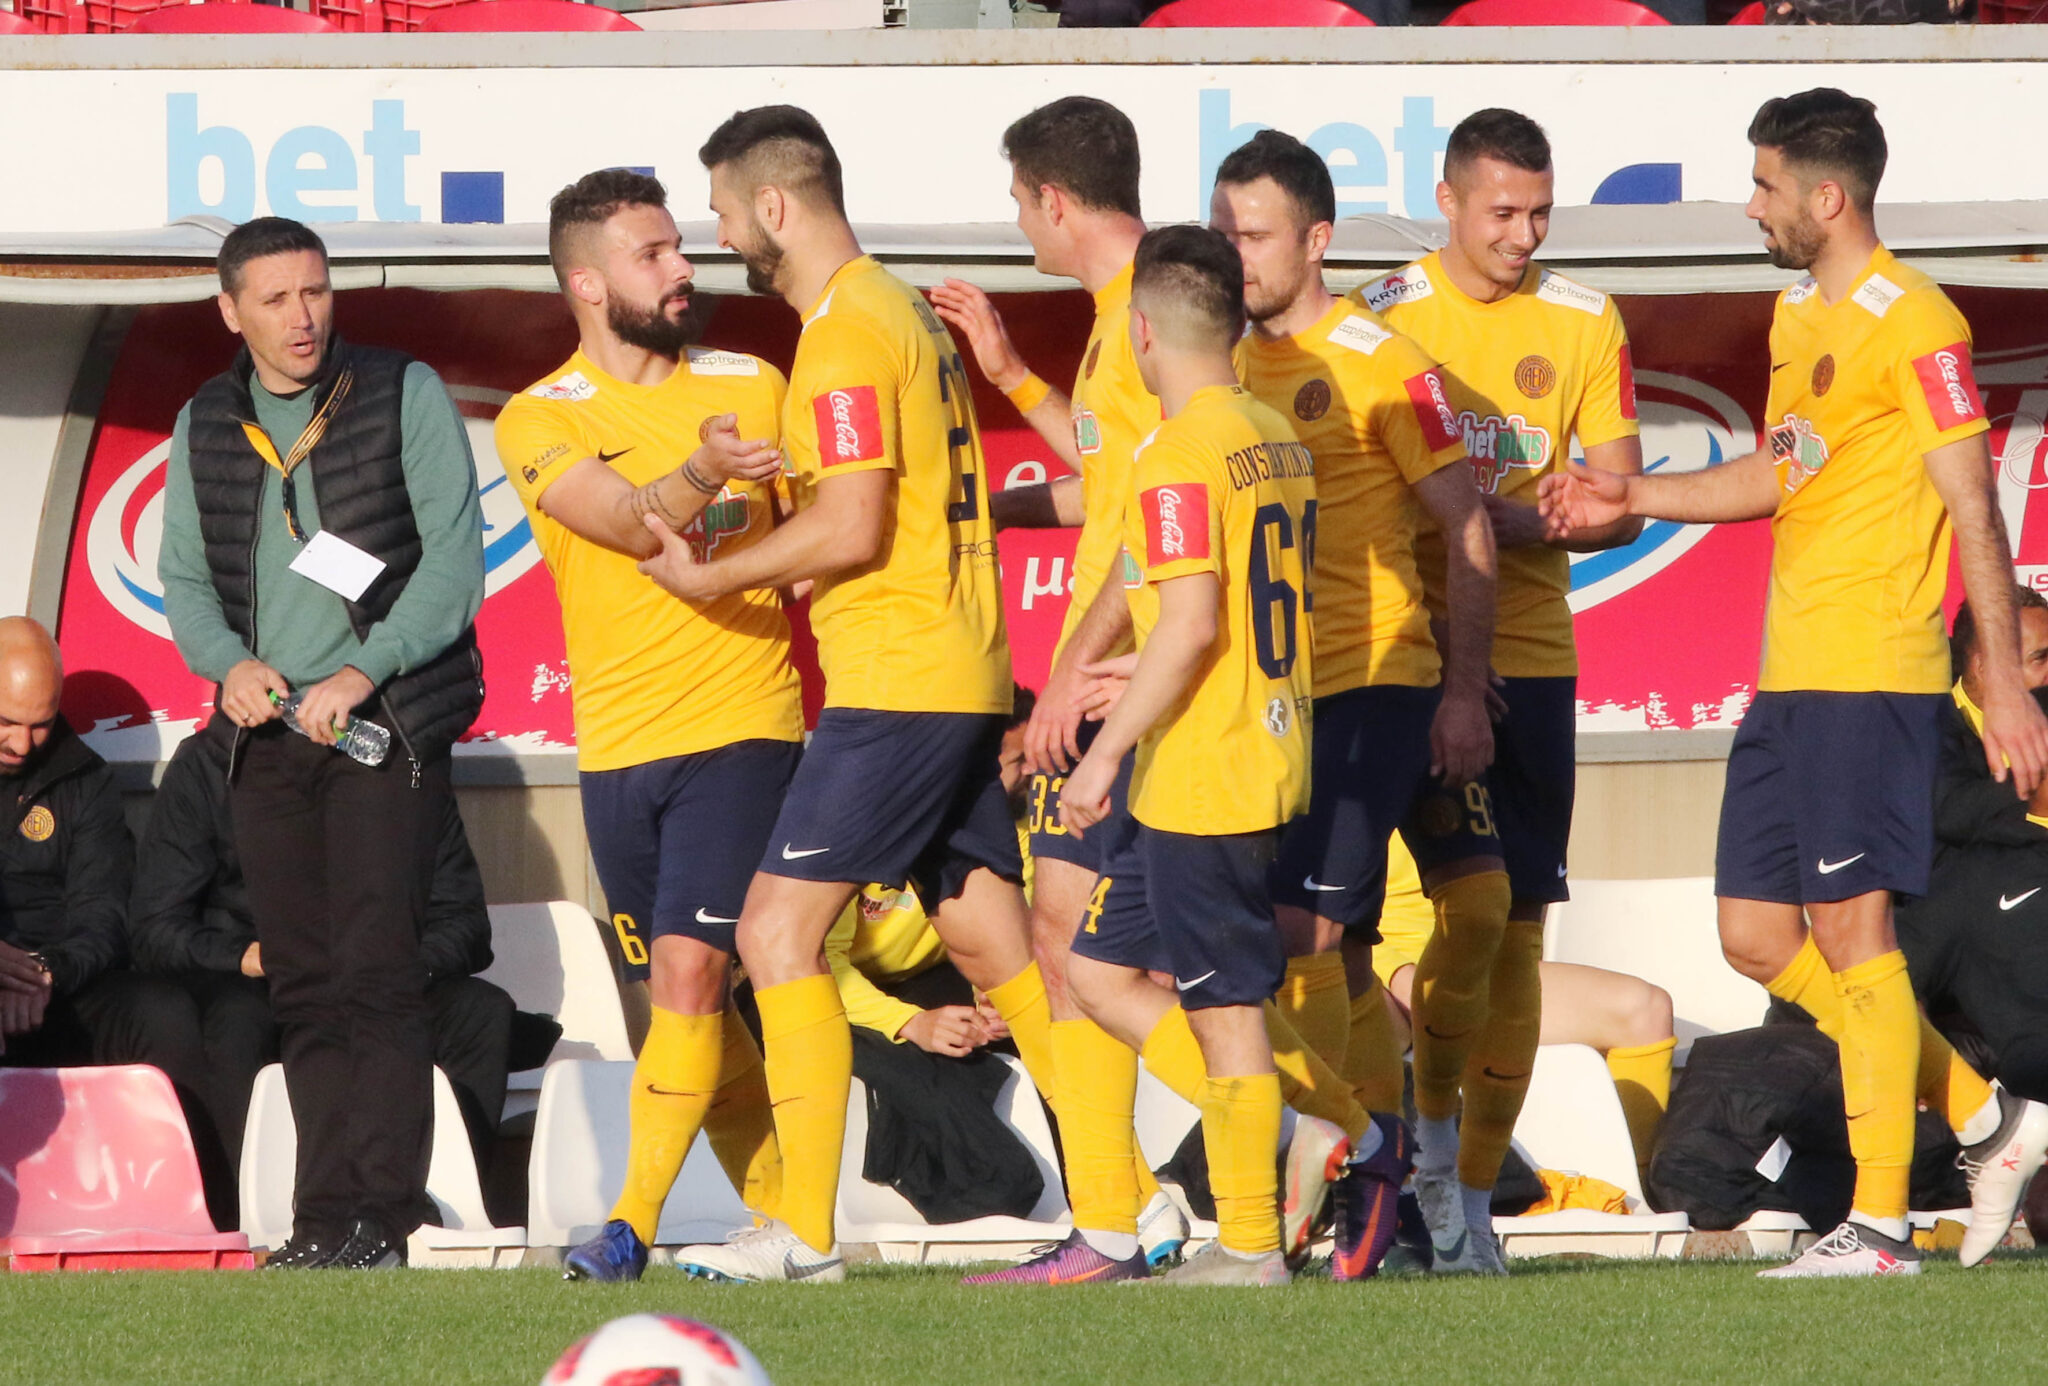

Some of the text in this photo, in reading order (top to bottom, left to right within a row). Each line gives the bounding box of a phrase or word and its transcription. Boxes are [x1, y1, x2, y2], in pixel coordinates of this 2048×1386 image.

[165, 92, 421, 223] bet
[1369, 280, 1427, 305] KRYPTO
[1084, 876, 1113, 934] 4
[612, 913, 649, 966] 6
